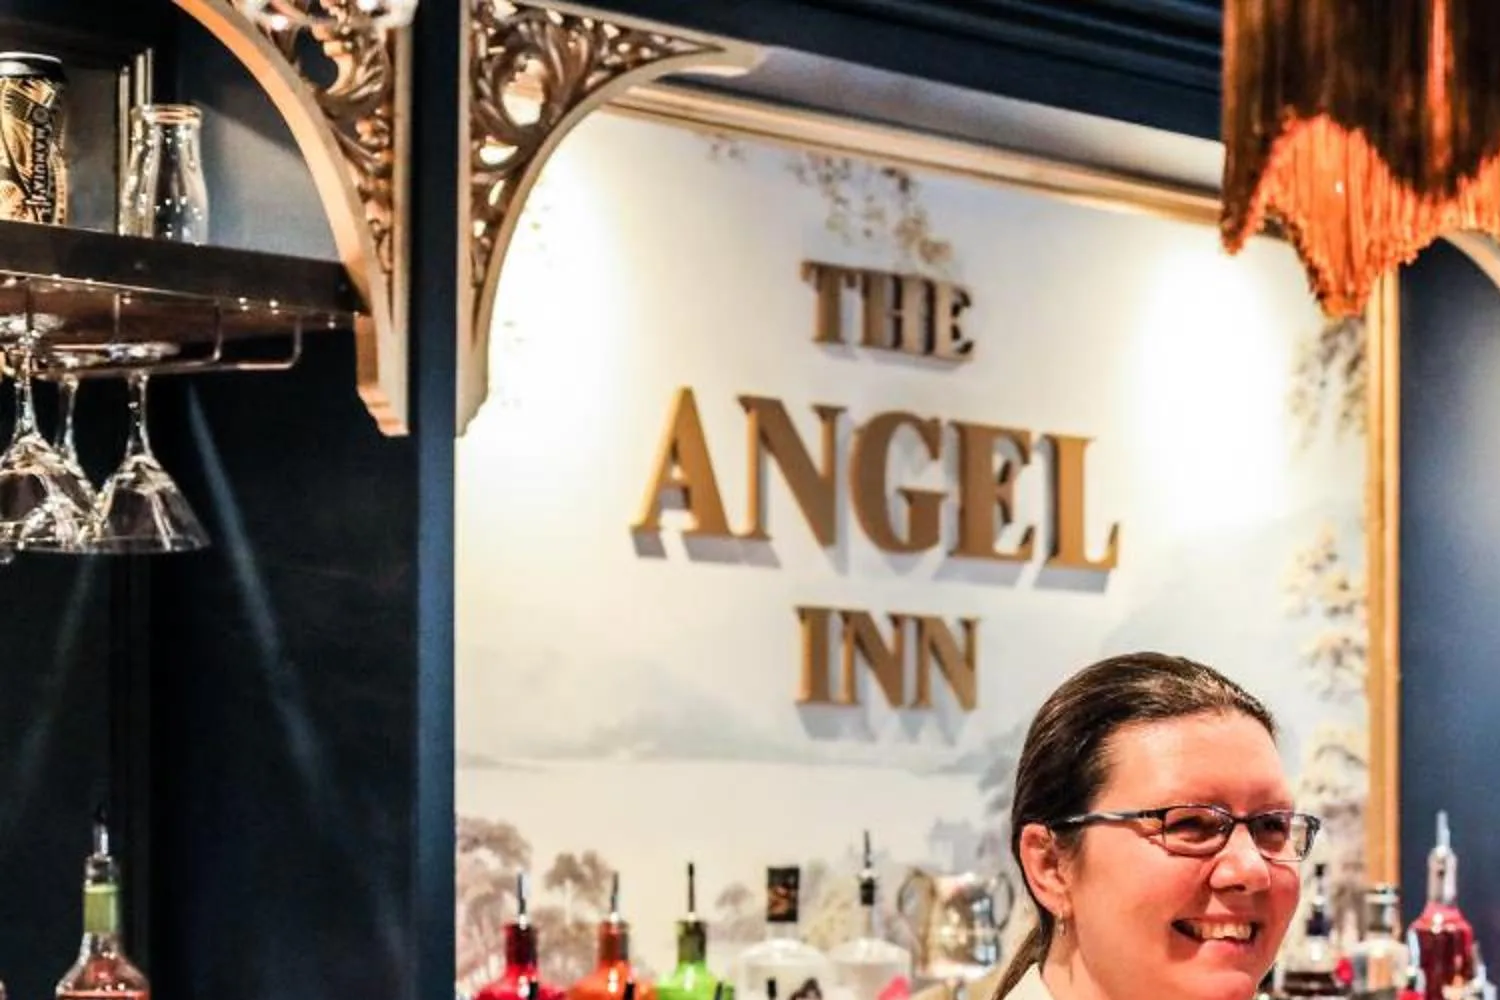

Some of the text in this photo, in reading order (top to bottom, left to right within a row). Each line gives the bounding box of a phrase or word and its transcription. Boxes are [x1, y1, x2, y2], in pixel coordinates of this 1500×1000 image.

[801, 260, 975, 363] THE
[630, 386, 1119, 571] ANGEL
[793, 605, 981, 713] INN
